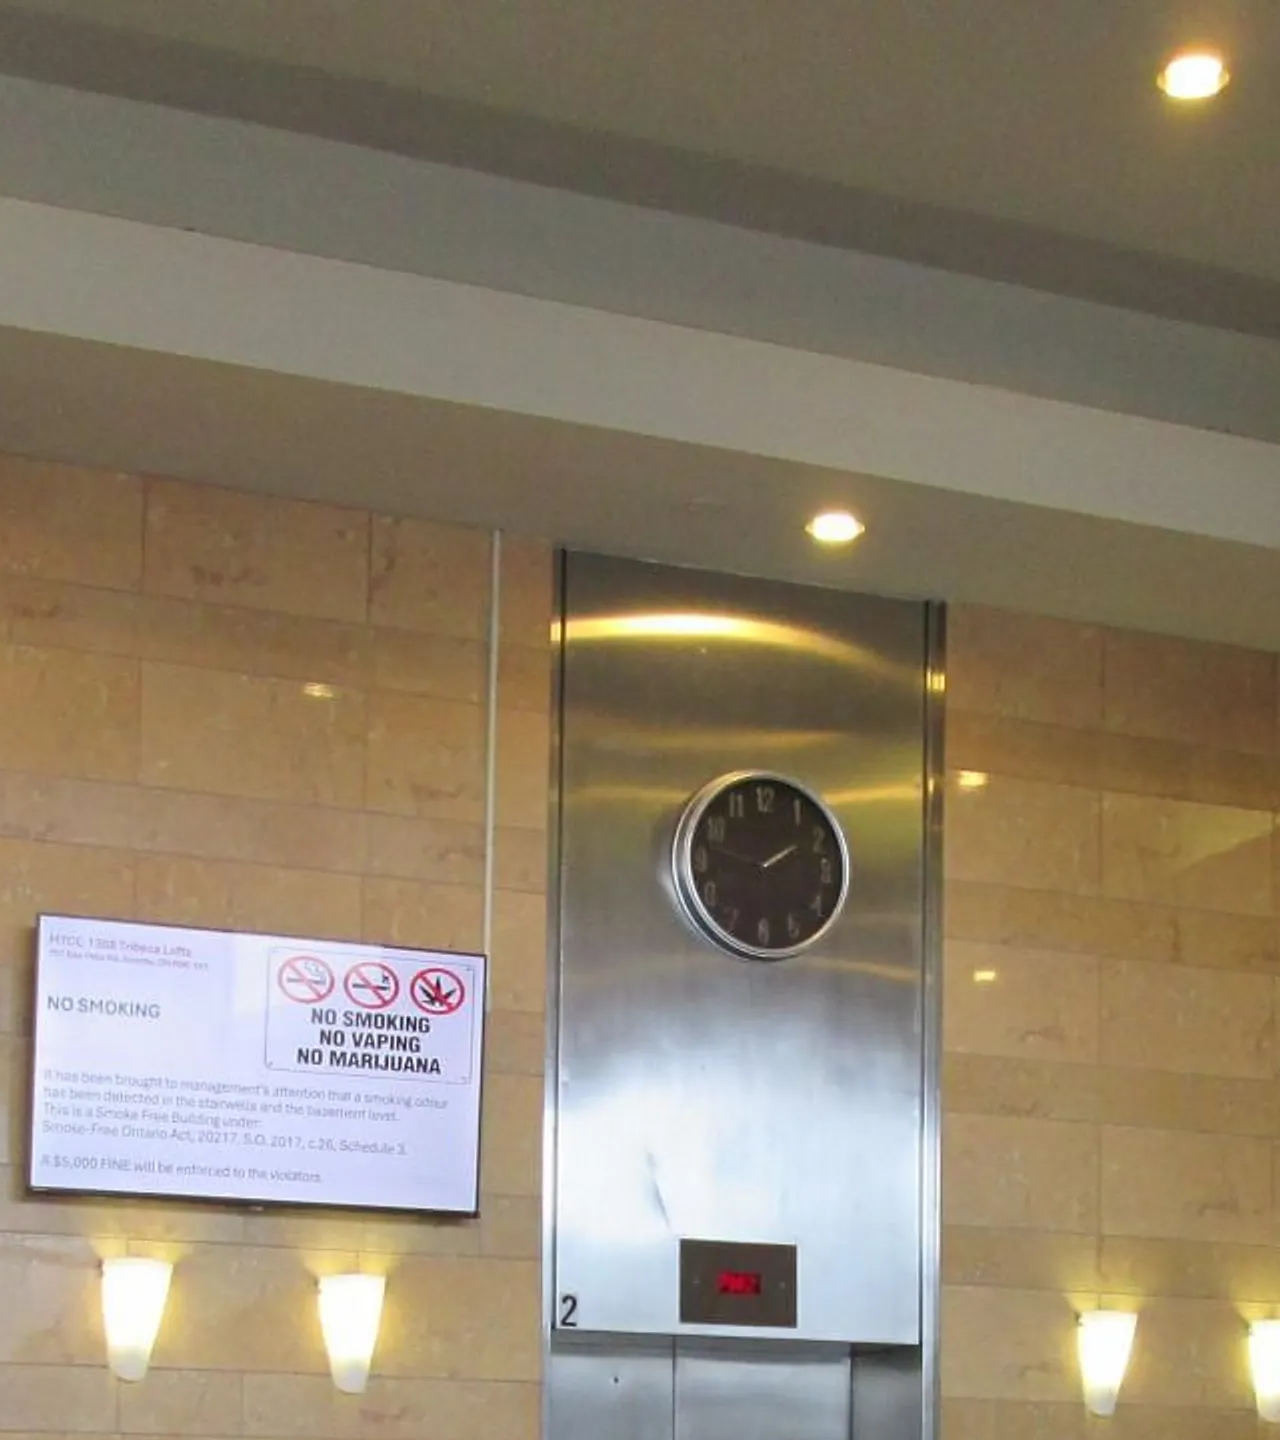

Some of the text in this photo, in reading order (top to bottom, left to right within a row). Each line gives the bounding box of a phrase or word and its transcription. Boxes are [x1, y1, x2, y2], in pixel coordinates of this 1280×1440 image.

[729, 792, 744, 817] 11
[756, 787, 774, 813] 12
[794, 800, 801, 826] 1
[758, 918, 770, 945] 6
[47, 995, 161, 1019] NO SMOKING
[311, 1007, 431, 1034] NO SMOKING
[320, 1029, 421, 1054] NO VAPING
[297, 1047, 442, 1075] NO MARIJUANA
[43, 1086, 66, 1098] has
[69, 1087, 100, 1101] been
[103, 1090, 159, 1106] detected
[162, 1094, 173, 1106] in
[176, 1095, 196, 1107] the
[260, 1102, 282, 1114] and
[285, 1102, 304, 1115] the
[307, 1105, 365, 1120] basement
[55, 1070, 78, 1083] has
[80, 1072, 113, 1085] been
[115, 1074, 161, 1091] brought
[164, 1077, 177, 1090] to
[272, 1086, 325, 1100] attention
[328, 1089, 351, 1101] that
[354, 1093, 362, 1103] a
[364, 1092, 412, 1109] smoking
[44, 1101, 69, 1115] This
[72, 1104, 82, 1117] is
[85, 1107, 93, 1117] a
[95, 1105, 138, 1120] Smoke
[141, 1108, 169, 1123] Free
[172, 1110, 219, 1129] Building
[42, 1119, 119, 1137] Smoke-Free
[122, 1123, 167, 1139] Ontario
[271, 1134, 305, 1150] 2017,
[339, 1139, 395, 1155] Schedule
[53, 1154, 98, 1169] $5,000
[100, 1157, 132, 1171] FINE
[134, 1158, 156, 1173] will
[159, 1160, 173, 1174] be
[176, 1163, 230, 1178] enforced
[233, 1166, 245, 1178] to
[248, 1167, 266, 1181] the
[560, 1295, 578, 1328] 2
